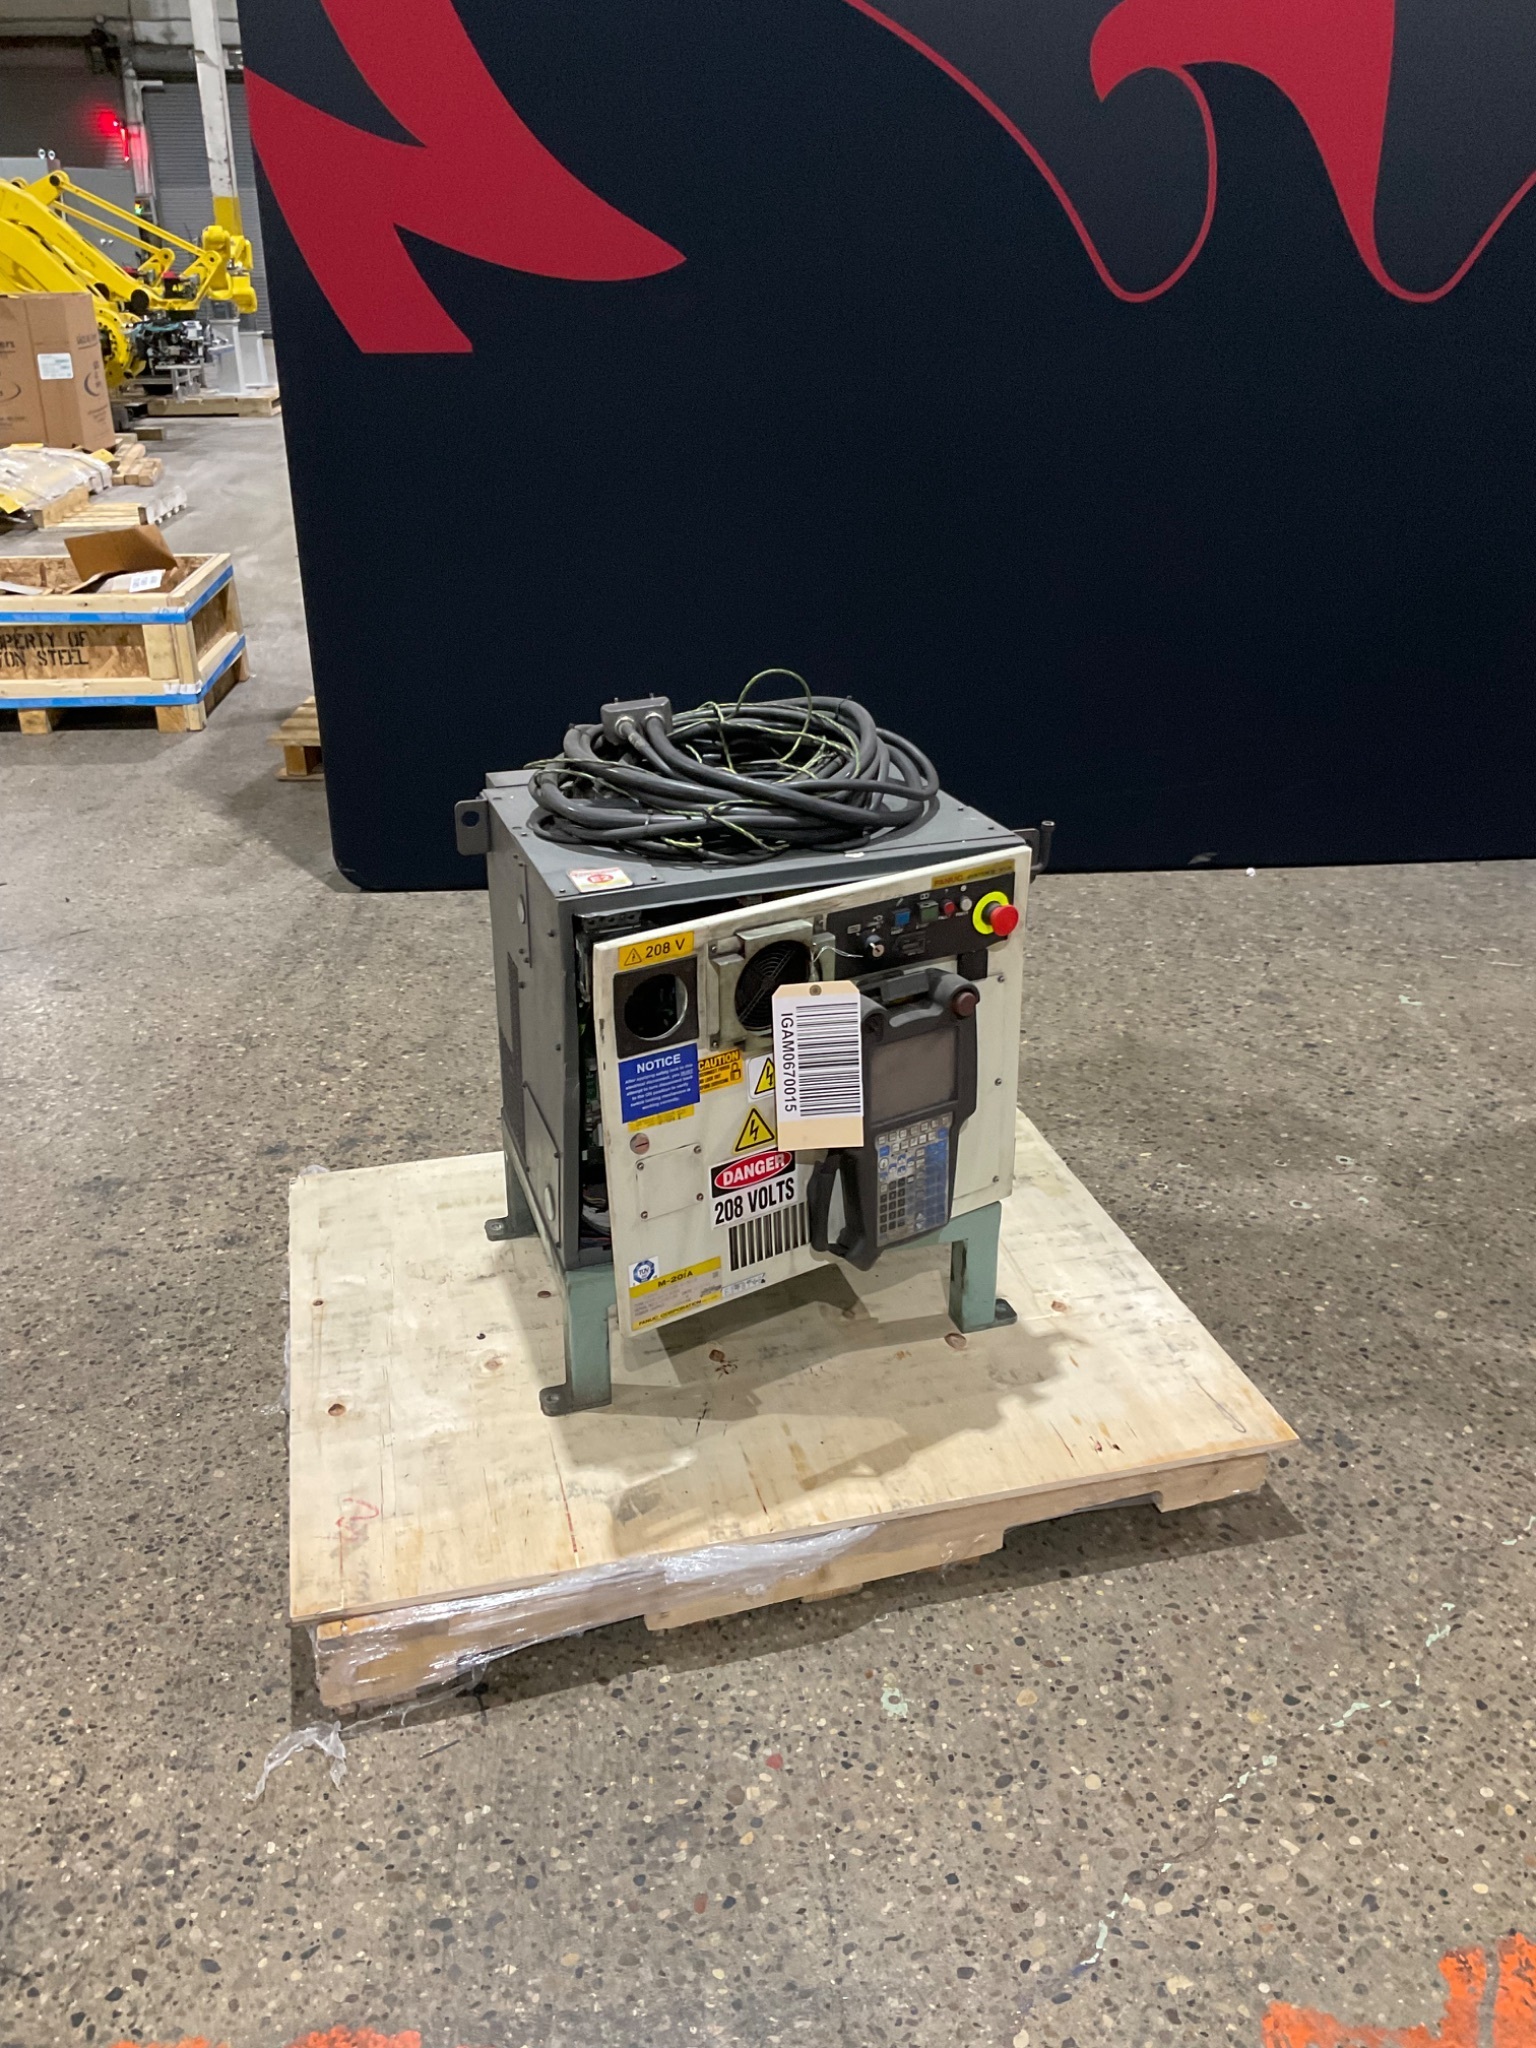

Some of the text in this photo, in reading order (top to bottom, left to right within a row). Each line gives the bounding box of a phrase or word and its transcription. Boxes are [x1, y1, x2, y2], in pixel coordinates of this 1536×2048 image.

[68, 631, 87, 647] OF
[37, 649, 88, 666] STEEL
[645, 938, 686, 958] 208 V
[636, 1054, 682, 1074] NOTICE
[698, 1050, 739, 1070] CAUTION
[780, 1012, 797, 1112] IGAM0670015
[722, 1154, 785, 1186] DANGER
[714, 1177, 794, 1224] 208 VOLTS
